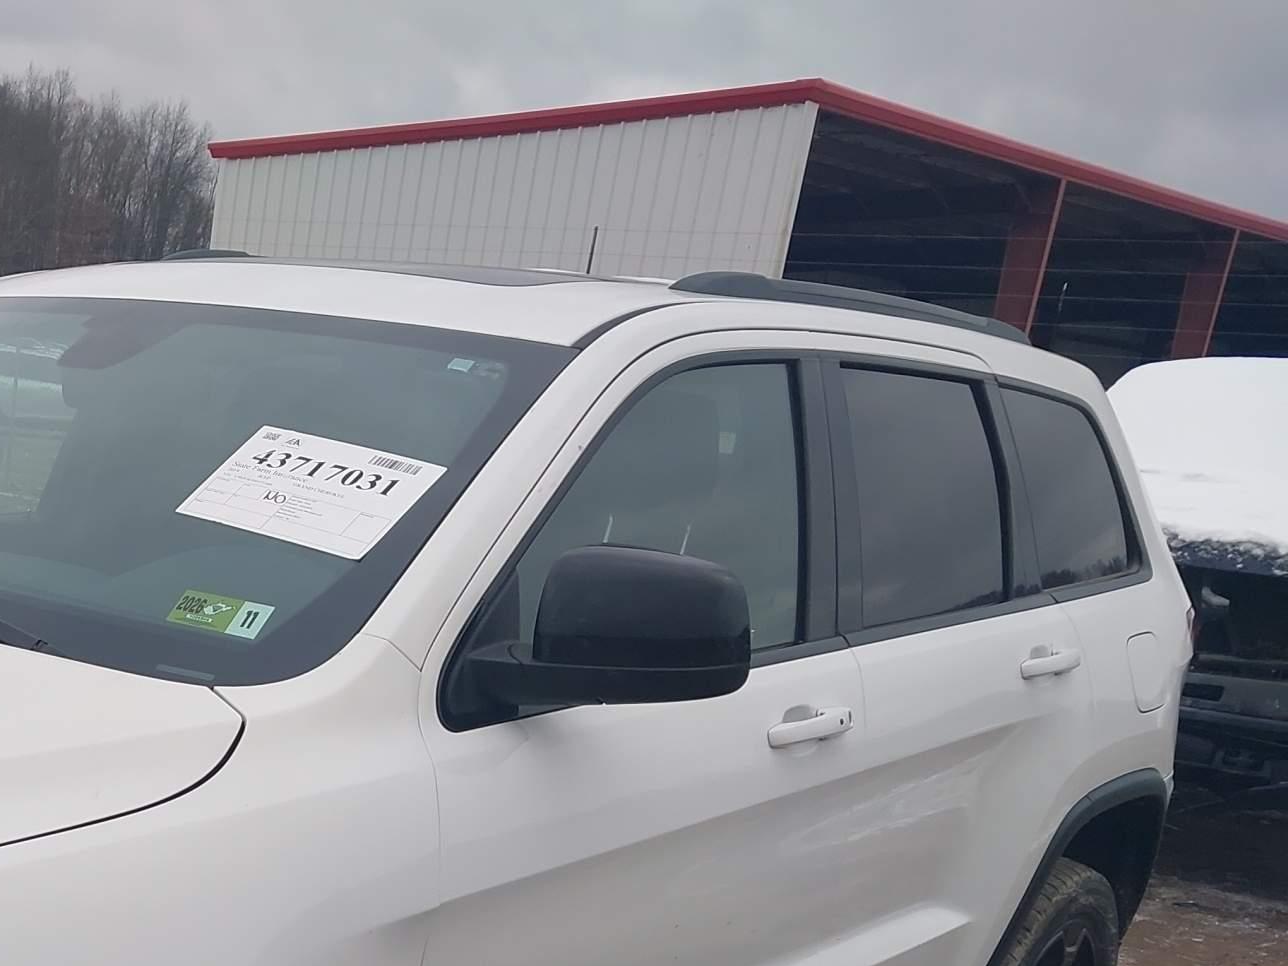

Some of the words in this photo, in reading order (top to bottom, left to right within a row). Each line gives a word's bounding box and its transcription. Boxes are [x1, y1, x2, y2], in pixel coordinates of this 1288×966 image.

[252, 449, 401, 497] 43717031
[176, 595, 208, 614] 2026
[240, 610, 259, 629] 11
